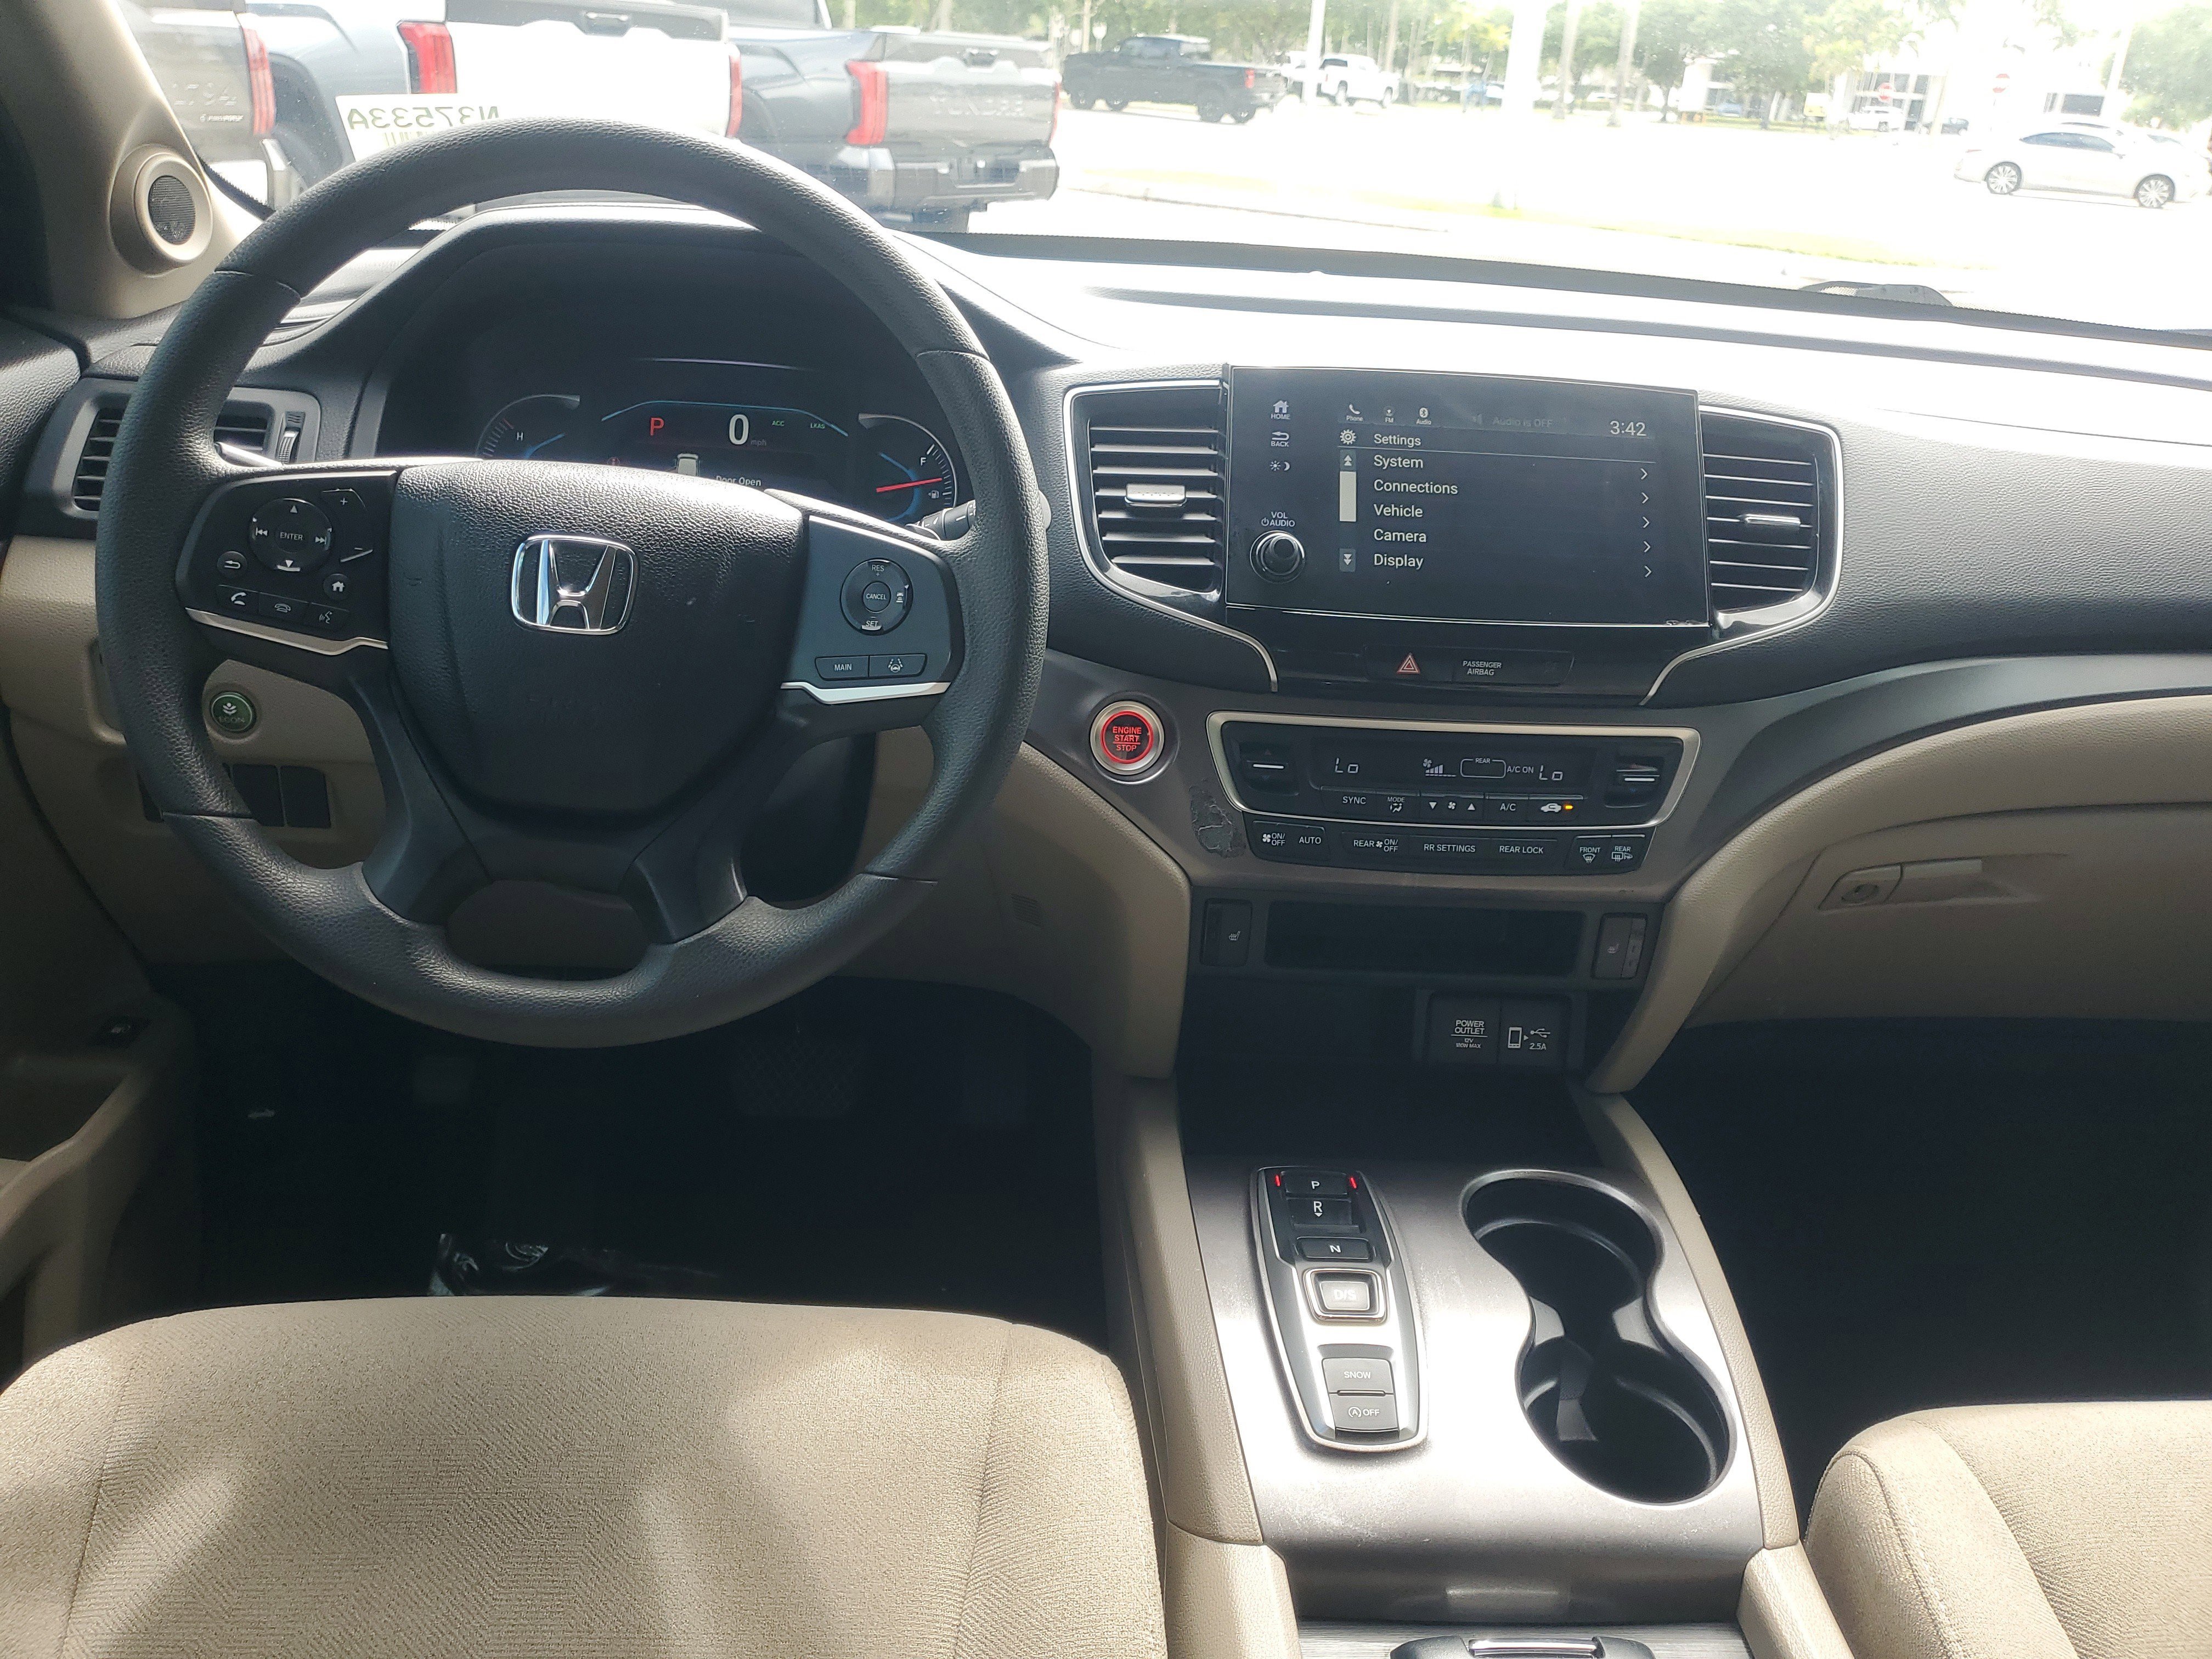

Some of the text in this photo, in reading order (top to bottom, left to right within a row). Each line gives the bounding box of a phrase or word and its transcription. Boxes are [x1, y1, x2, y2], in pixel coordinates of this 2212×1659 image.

[650, 417, 664, 436] P
[1534, 419, 1554, 428] OFF
[1610, 420, 1646, 436] 3:42
[729, 414, 750, 445] 0
[516, 432, 523, 441] H
[1374, 433, 1421, 448] Settings
[751, 438, 766, 447] mph
[920, 457, 927, 466] F
[1374, 455, 1424, 470] System
[738, 477, 762, 487] Open
[1374, 479, 1459, 495] Connections
[1373, 504, 1423, 518] Vehicle
[1269, 519, 1295, 527] AUDIO
[280, 532, 303, 541] ENTER
[1374, 529, 1426, 543] Camera
[1374, 554, 1424, 569] Display
[1463, 661, 1502, 669] PASSENGER
[1113, 726, 1142, 735] ENGINE
[1335, 757, 1359, 774] Lo
[1539, 765, 1563, 781] Lo
[1342, 796, 1366, 805] SYNC
[1500, 803, 1516, 811] A/C
[1353, 839, 1375, 848] REAR
[1437, 844, 1476, 853] SETTINGS
[1454, 1026, 1485, 1035] OUTLET
[1311, 1181, 1320, 1189] P
[1313, 1201, 1323, 1213] R
[1330, 1245, 1341, 1253] N
[1334, 1289, 1357, 1300] D/S
[1344, 1371, 1371, 1379] SNOW
